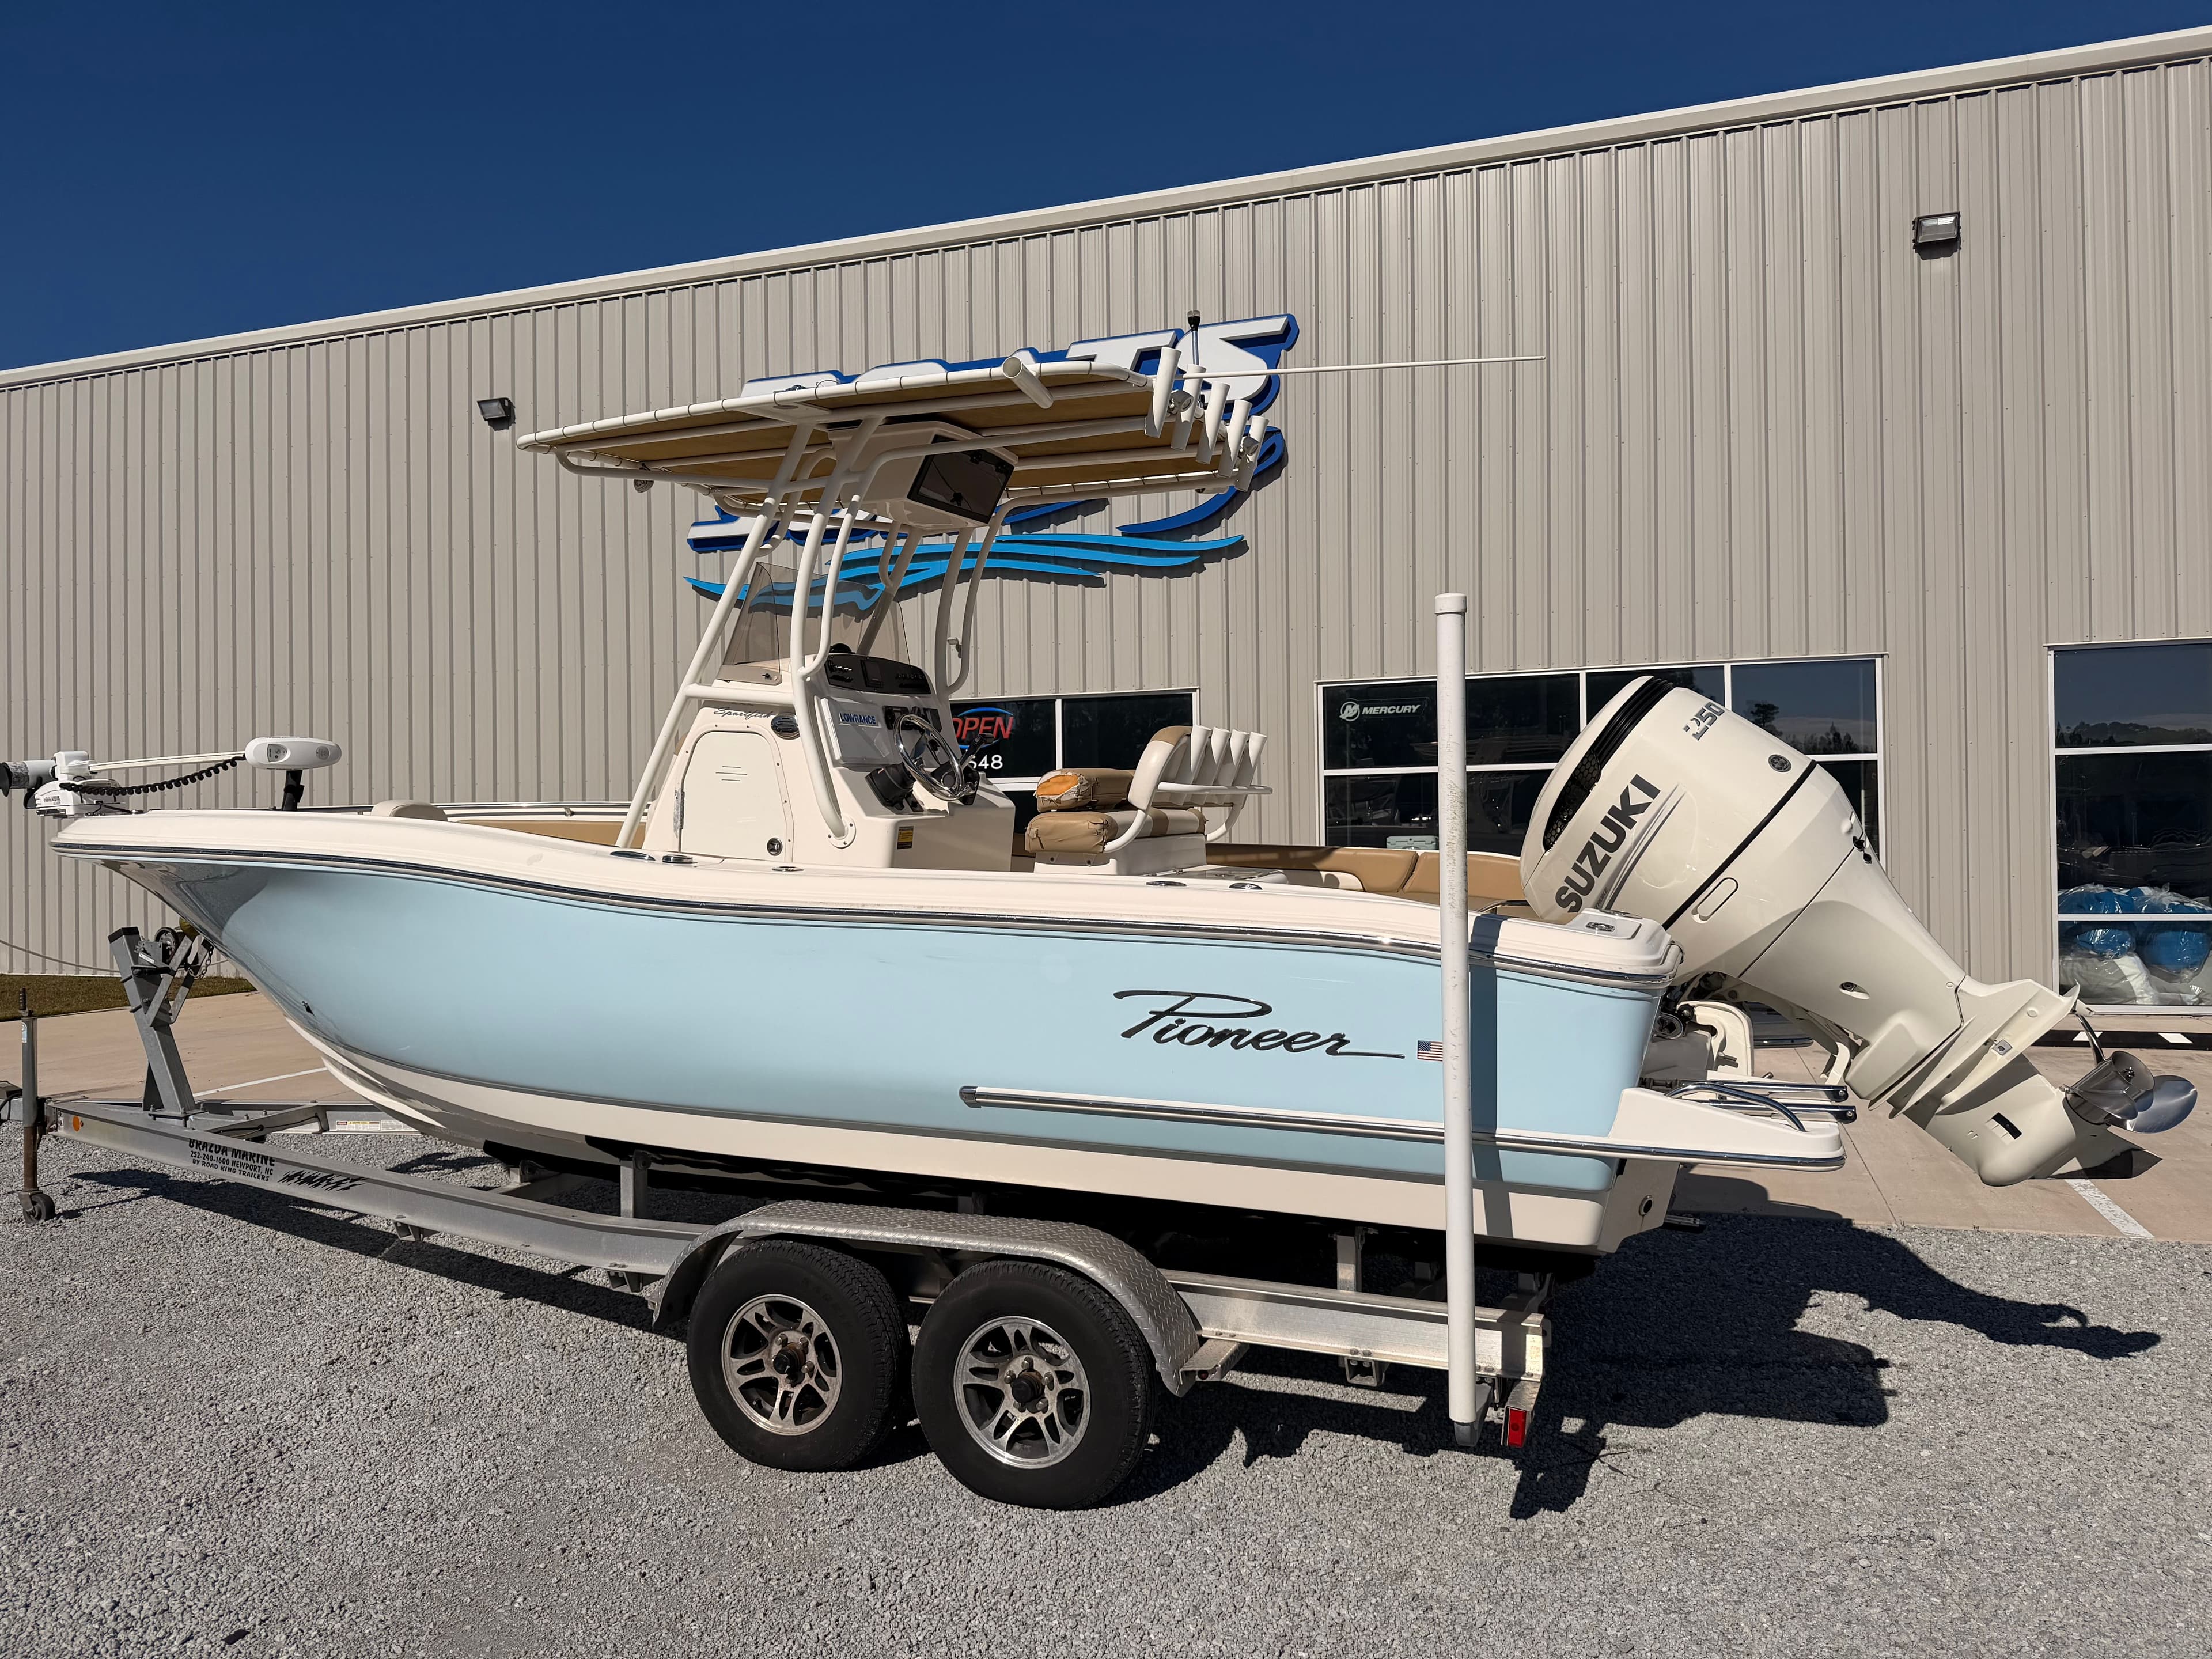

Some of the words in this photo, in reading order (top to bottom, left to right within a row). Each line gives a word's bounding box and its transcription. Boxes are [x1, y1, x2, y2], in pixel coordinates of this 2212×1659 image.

[839, 712, 877, 725] LOWRANCE
[1362, 704, 1421, 715] MERCURY
[1555, 774, 1661, 913] SUZUKI
[1113, 990, 1406, 1059] Pioneer
[190, 1150, 230, 1166] 252-240-1600
[231, 1160, 263, 1175] NEWPORT,
[264, 1167, 274, 1176] NC
[231, 1148, 275, 1167] MARINE
[202, 1161, 218, 1169] ROAD
[220, 1165, 236, 1174] KING
[238, 1169, 270, 1181] TRAILERS
